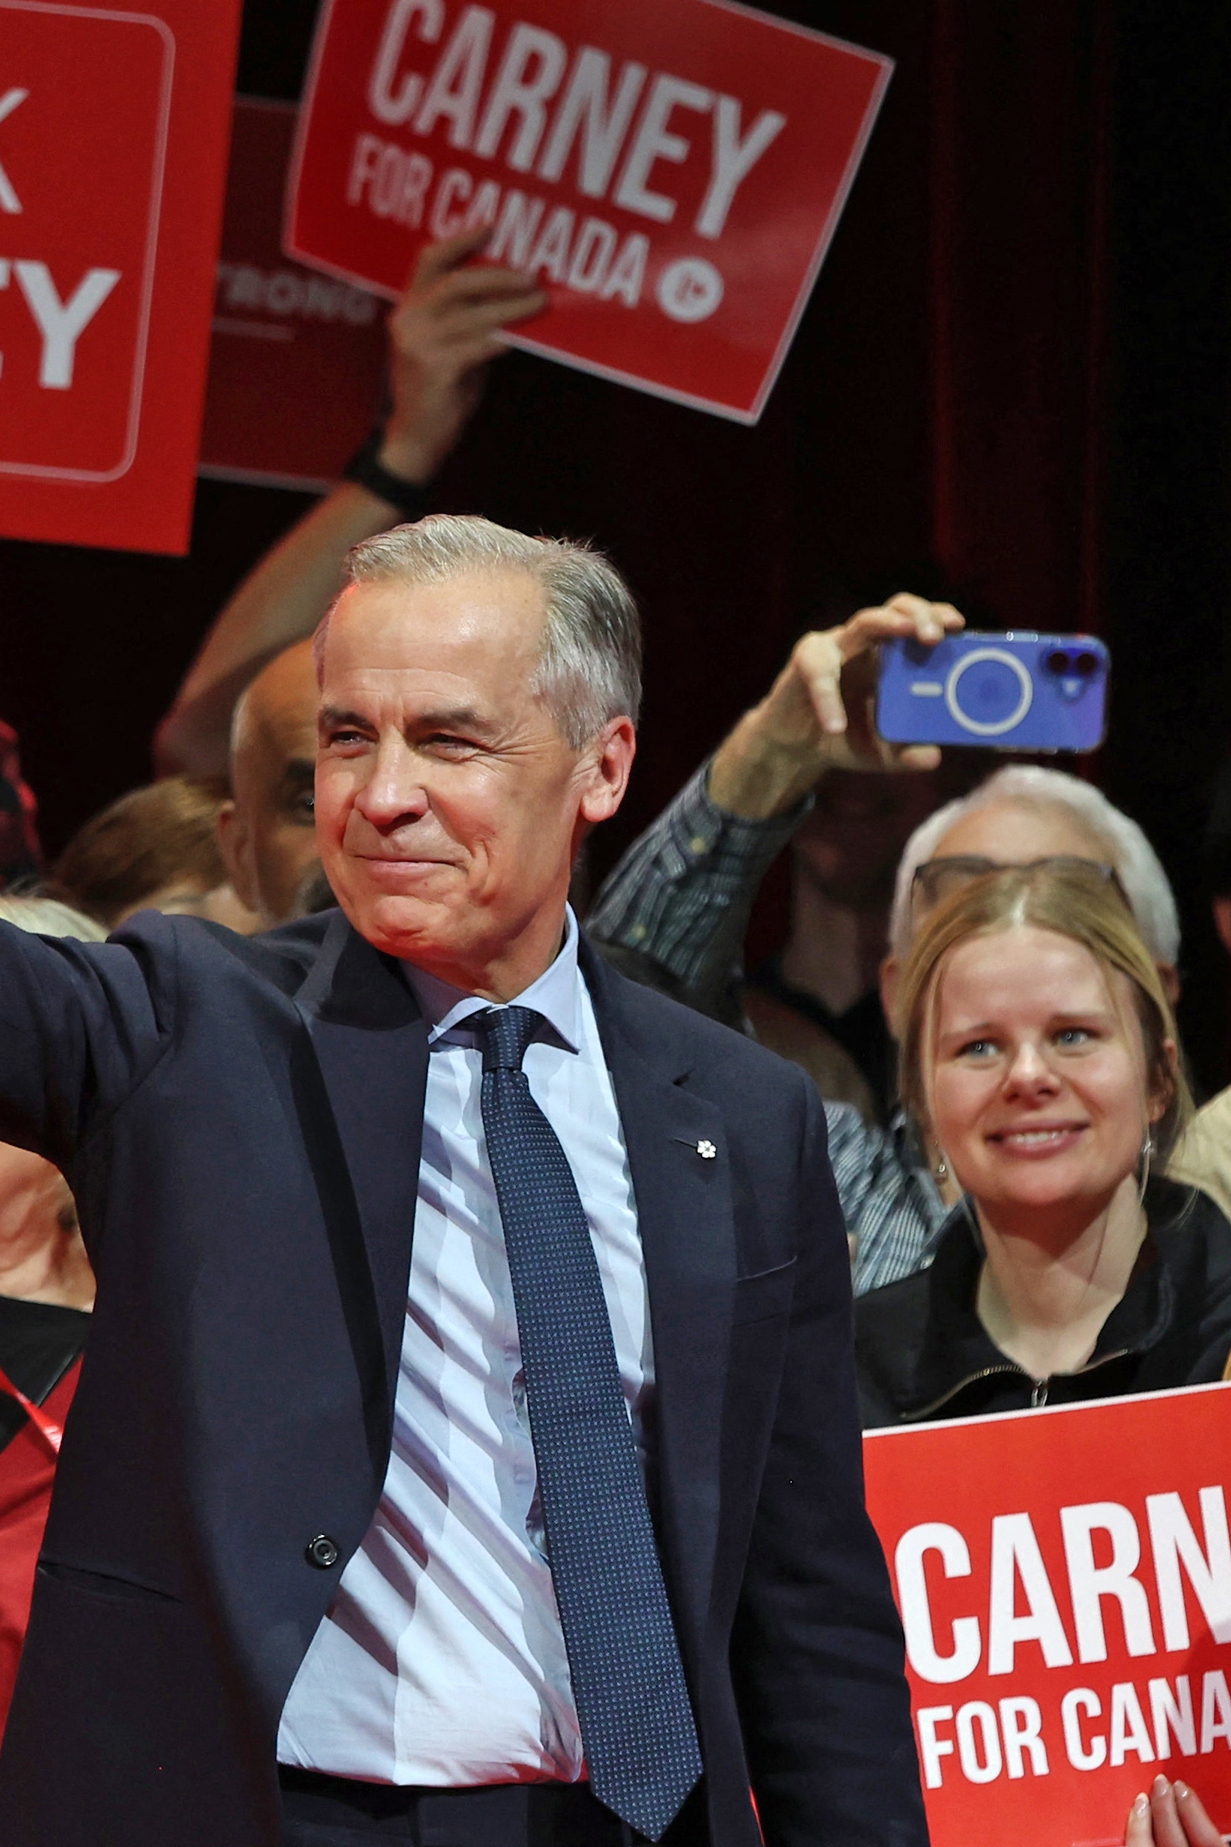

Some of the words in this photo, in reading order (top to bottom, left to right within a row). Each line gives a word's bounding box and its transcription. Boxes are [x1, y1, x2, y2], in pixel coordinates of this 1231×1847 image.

[370, 0, 787, 239] CARNEY
[347, 134, 434, 229] FOR
[428, 168, 650, 309] CANADA
[894, 1486, 1231, 1684] CARN
[916, 1696, 1049, 1789] FOR
